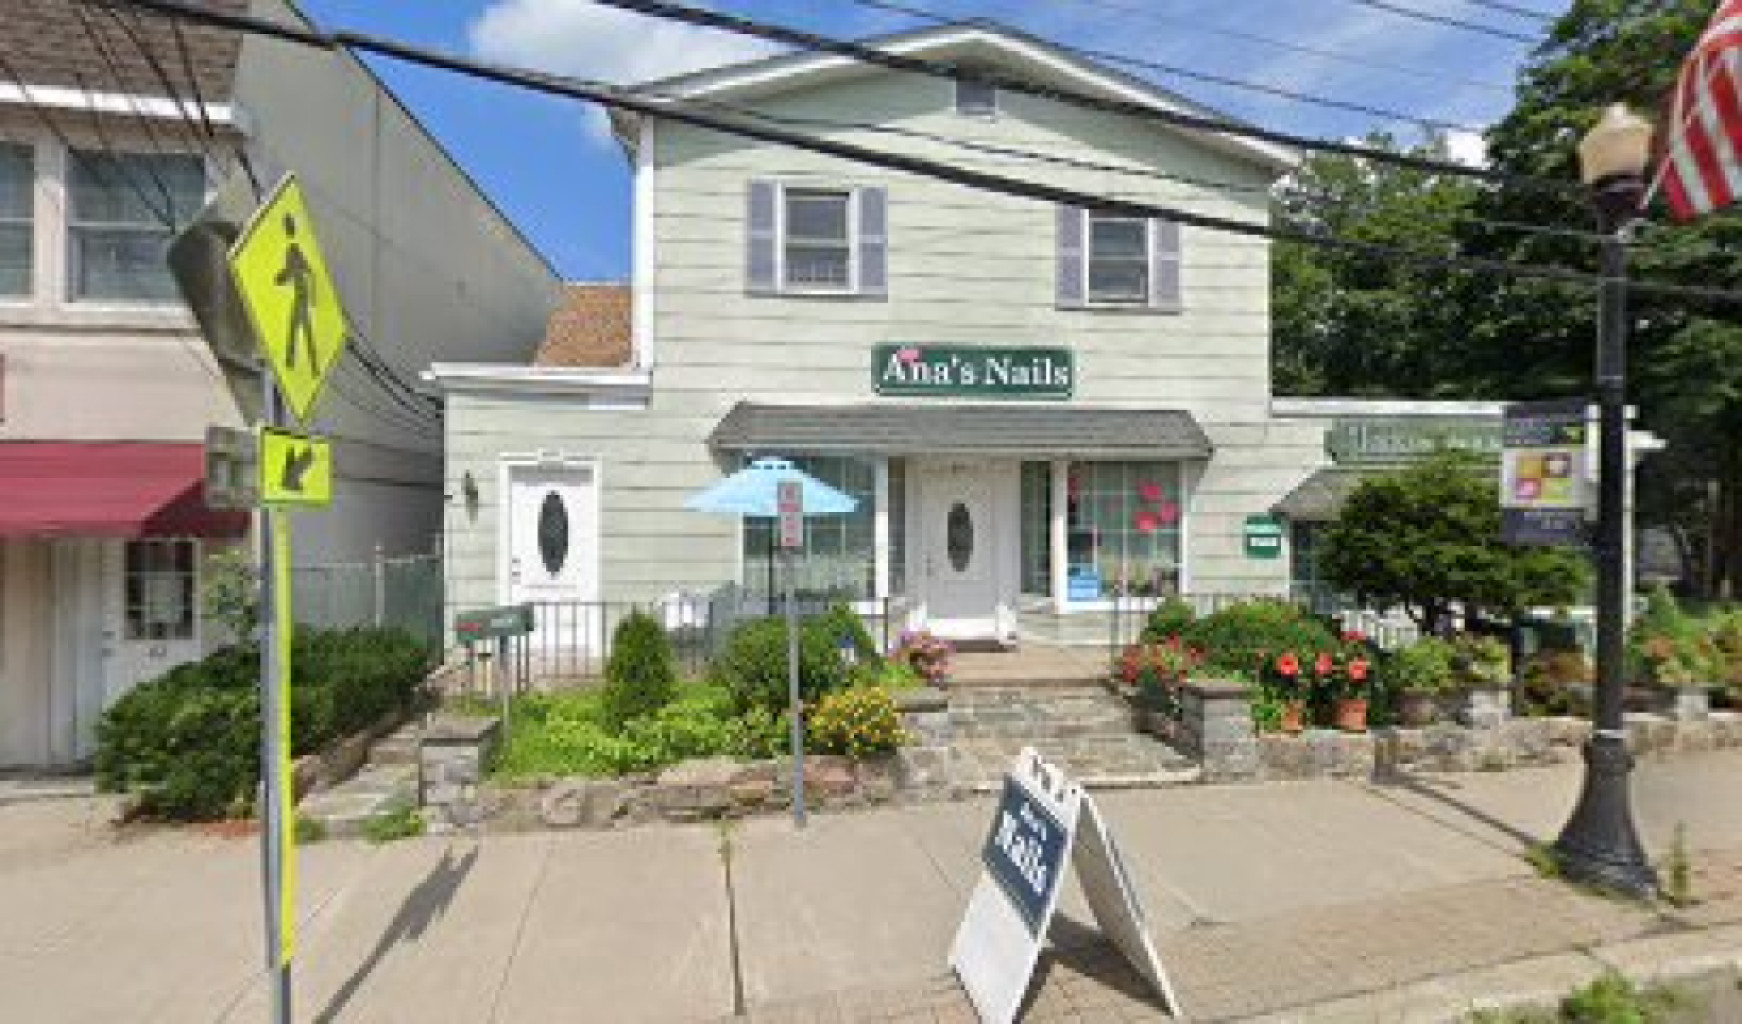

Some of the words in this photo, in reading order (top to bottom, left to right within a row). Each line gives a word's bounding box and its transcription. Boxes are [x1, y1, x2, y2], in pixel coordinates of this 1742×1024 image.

[882, 351, 976, 385] Ana's
[984, 356, 1070, 386] Nails
[994, 809, 1047, 896] Nails
